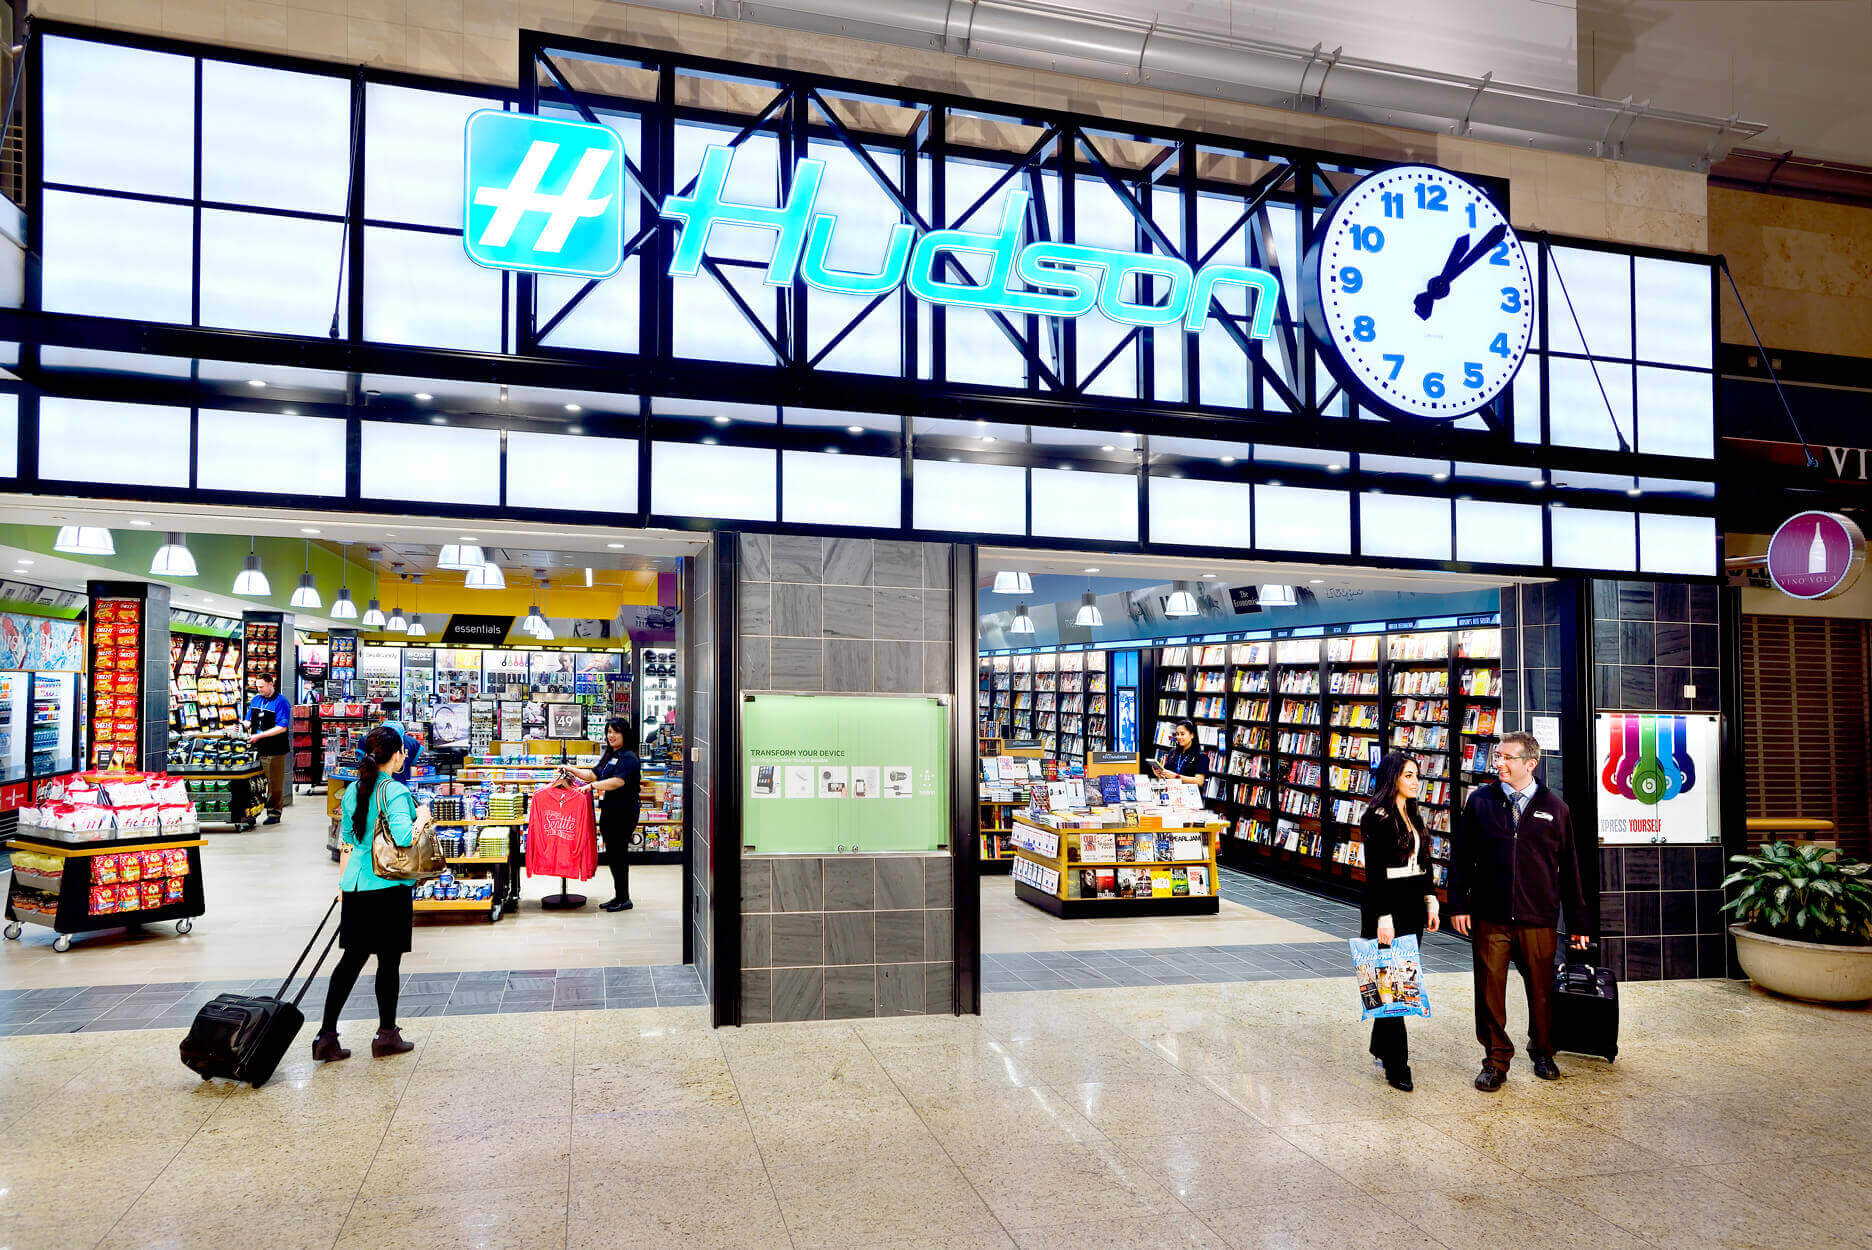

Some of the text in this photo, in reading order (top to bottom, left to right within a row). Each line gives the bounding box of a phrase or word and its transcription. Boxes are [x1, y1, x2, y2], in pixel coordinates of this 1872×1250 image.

[1381, 191, 1403, 219] 11
[1414, 183, 1448, 211] 12
[1465, 203, 1477, 228] 1
[659, 144, 1280, 340] Hudson
[1349, 224, 1385, 253] 10
[1489, 240, 1510, 266] 2
[1339, 266, 1364, 294] 9
[1500, 287, 1521, 313] 3
[1353, 315, 1376, 342] 8
[1489, 332, 1511, 358] 4
[1383, 354, 1405, 380] 7
[1463, 362, 1484, 388] 5
[1423, 372, 1445, 398] 6
[1780, 577, 1805, 586] VINO
[1239, 591, 1249, 599] The
[454, 624, 502, 635] essentials
[751, 749, 797, 757] TRANSFORM
[1628, 818, 1662, 833] YOURSELF
